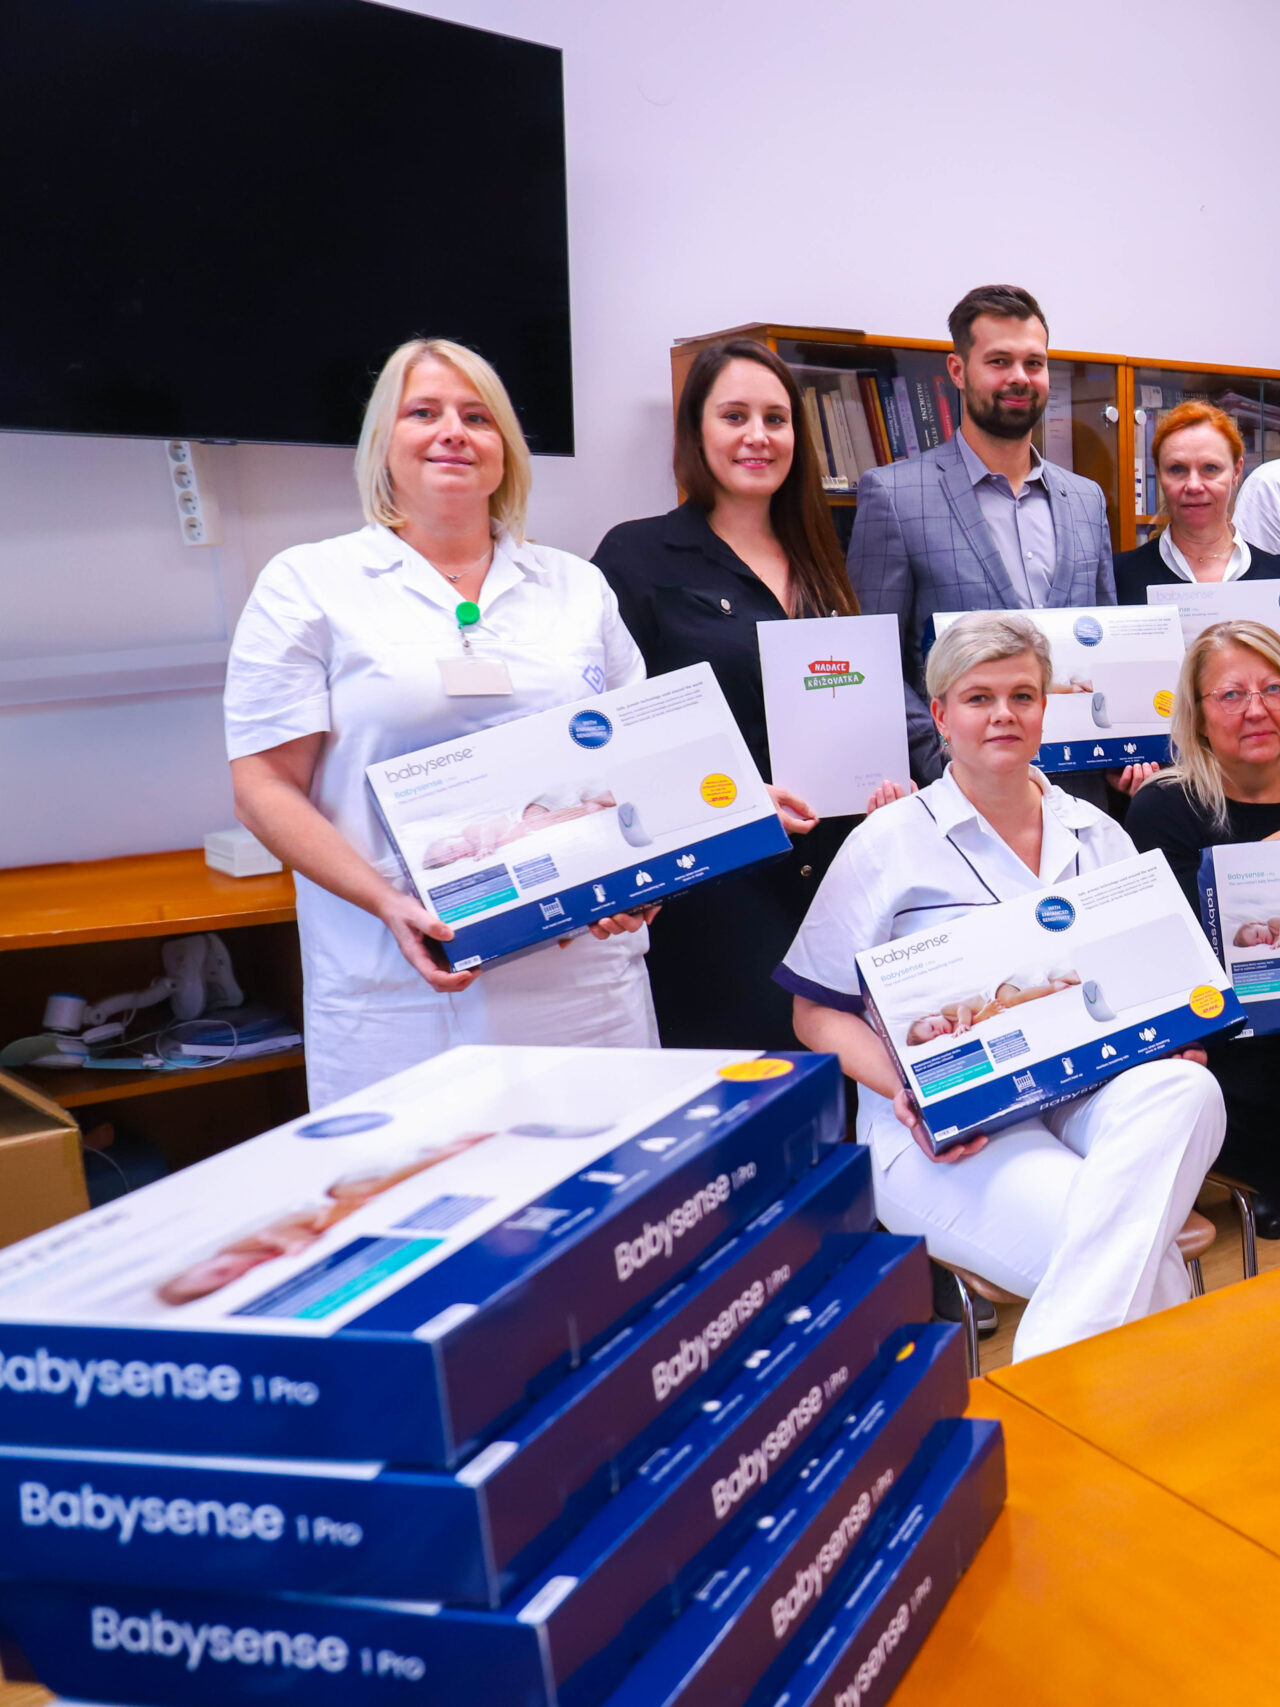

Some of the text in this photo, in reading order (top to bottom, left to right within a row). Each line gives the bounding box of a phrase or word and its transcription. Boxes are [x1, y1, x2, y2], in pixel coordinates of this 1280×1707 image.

[916, 382, 928, 421] MEDICINE
[807, 674, 860, 688] KŘIŽOVATKA
[814, 663, 847, 672] NADACE
[384, 746, 474, 784] babysense
[1227, 871, 1265, 881] Babysense
[871, 934, 949, 968] babysense
[881, 962, 924, 982] Babysense
[614, 1173, 730, 1282] Babysense
[737, 1162, 757, 1187] Pro
[652, 1280, 764, 1402] Babysense
[771, 1264, 791, 1289] Pro
[252, 1374, 267, 1404] 1
[270, 1375, 320, 1406] Pro
[711, 1385, 822, 1520] Babysense
[829, 1366, 848, 1394] Pro
[19, 1481, 364, 1554] Babysense 1 Pro
[771, 1492, 871, 1640] Babysense
[91, 1606, 427, 1682] Babysense 1 Pro
